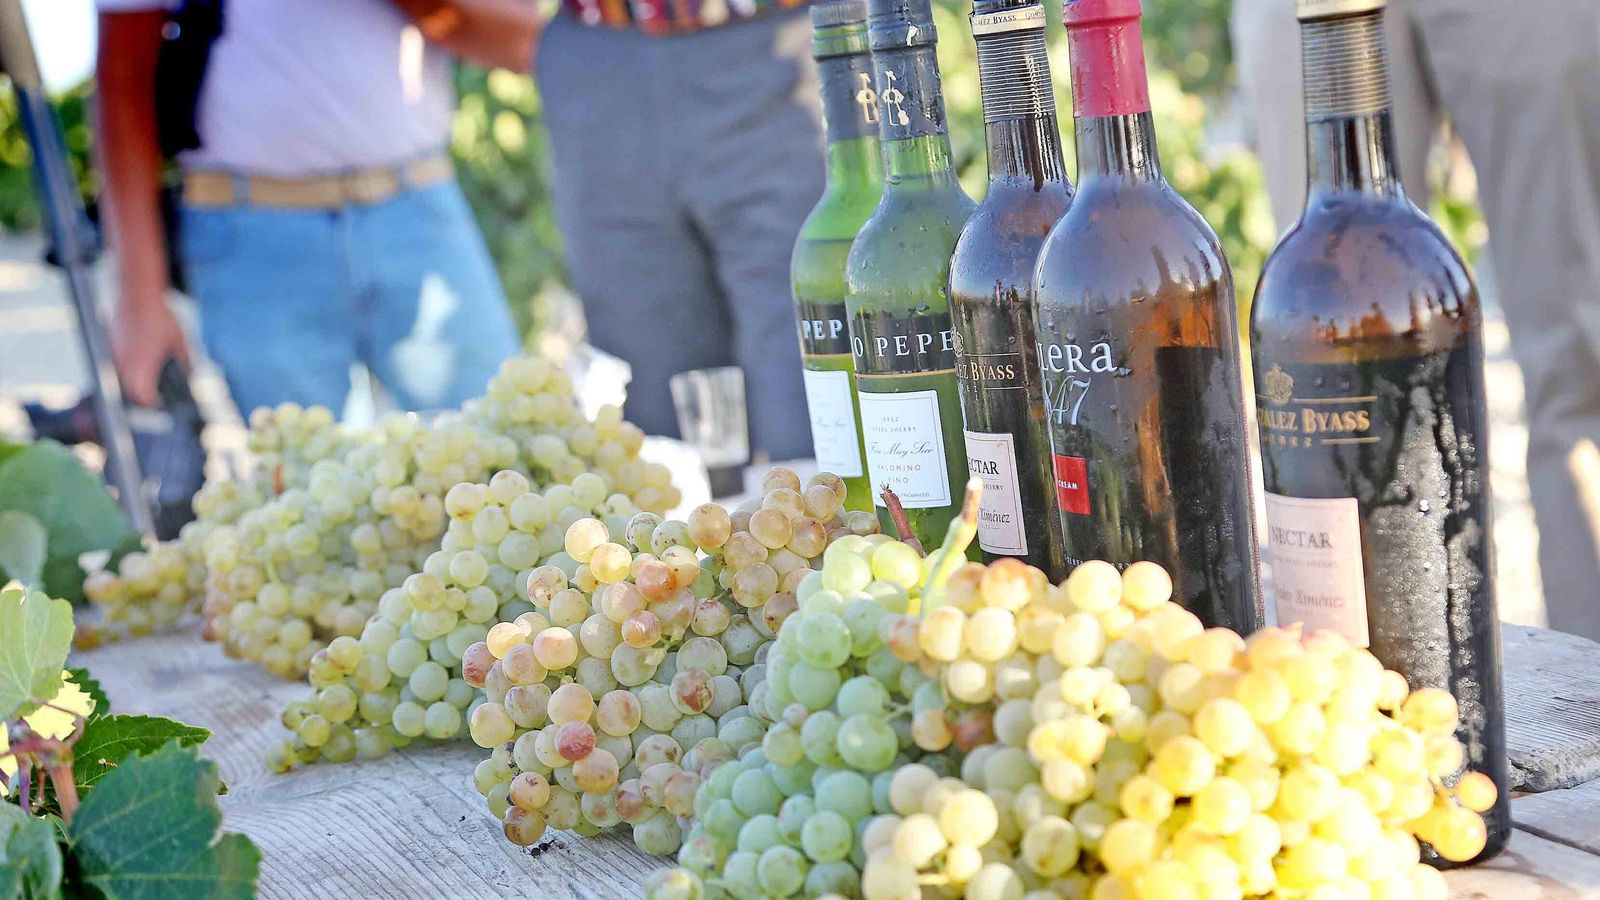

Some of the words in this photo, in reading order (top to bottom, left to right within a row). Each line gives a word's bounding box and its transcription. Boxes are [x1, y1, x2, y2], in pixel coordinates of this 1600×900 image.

[993, 14, 1017, 24] BYASS
[802, 318, 843, 340] PEP
[875, 330, 954, 357] PEPE
[955, 362, 969, 380] LEZ
[970, 361, 1015, 381] BYASS
[1044, 375, 1091, 425] 847
[1301, 408, 1371, 434] BYASS
[1057, 480, 1078, 490] CREAM
[1272, 525, 1333, 549] NECTAR
